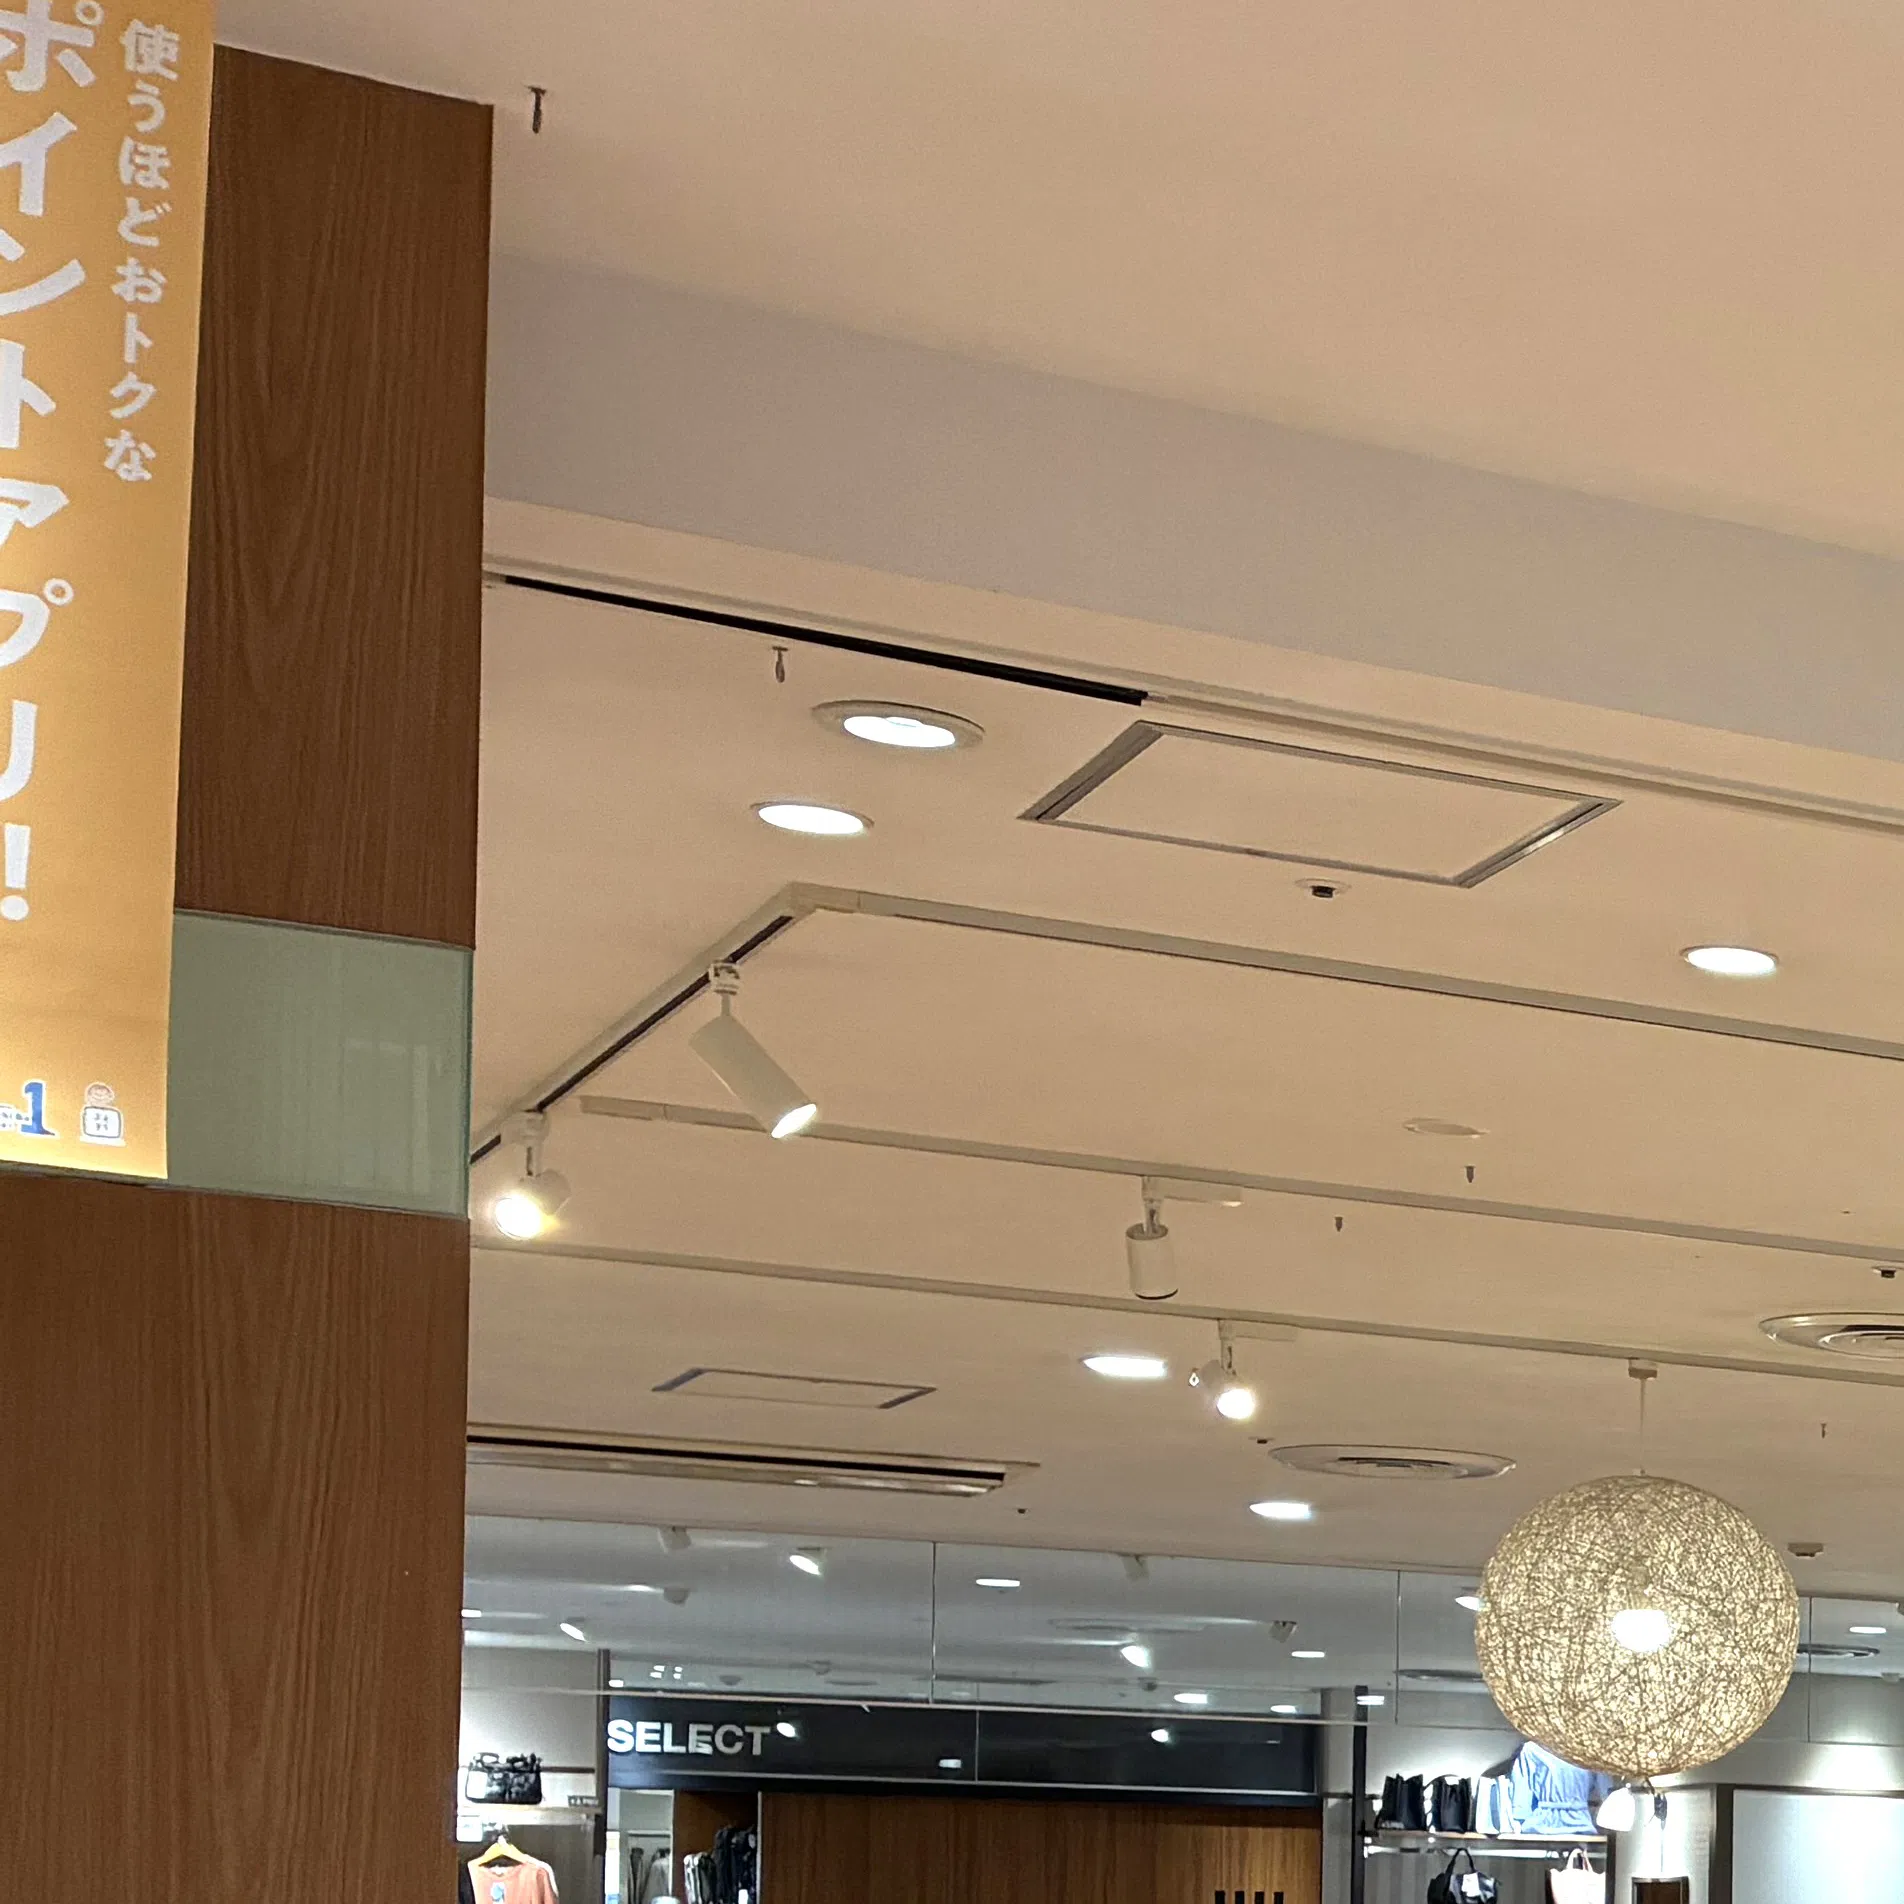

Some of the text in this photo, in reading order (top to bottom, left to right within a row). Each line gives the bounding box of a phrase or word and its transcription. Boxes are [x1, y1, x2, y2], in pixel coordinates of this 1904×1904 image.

[103, 18, 181, 482] 使うほどおトクな
[607, 1719, 771, 1756] SELECT
